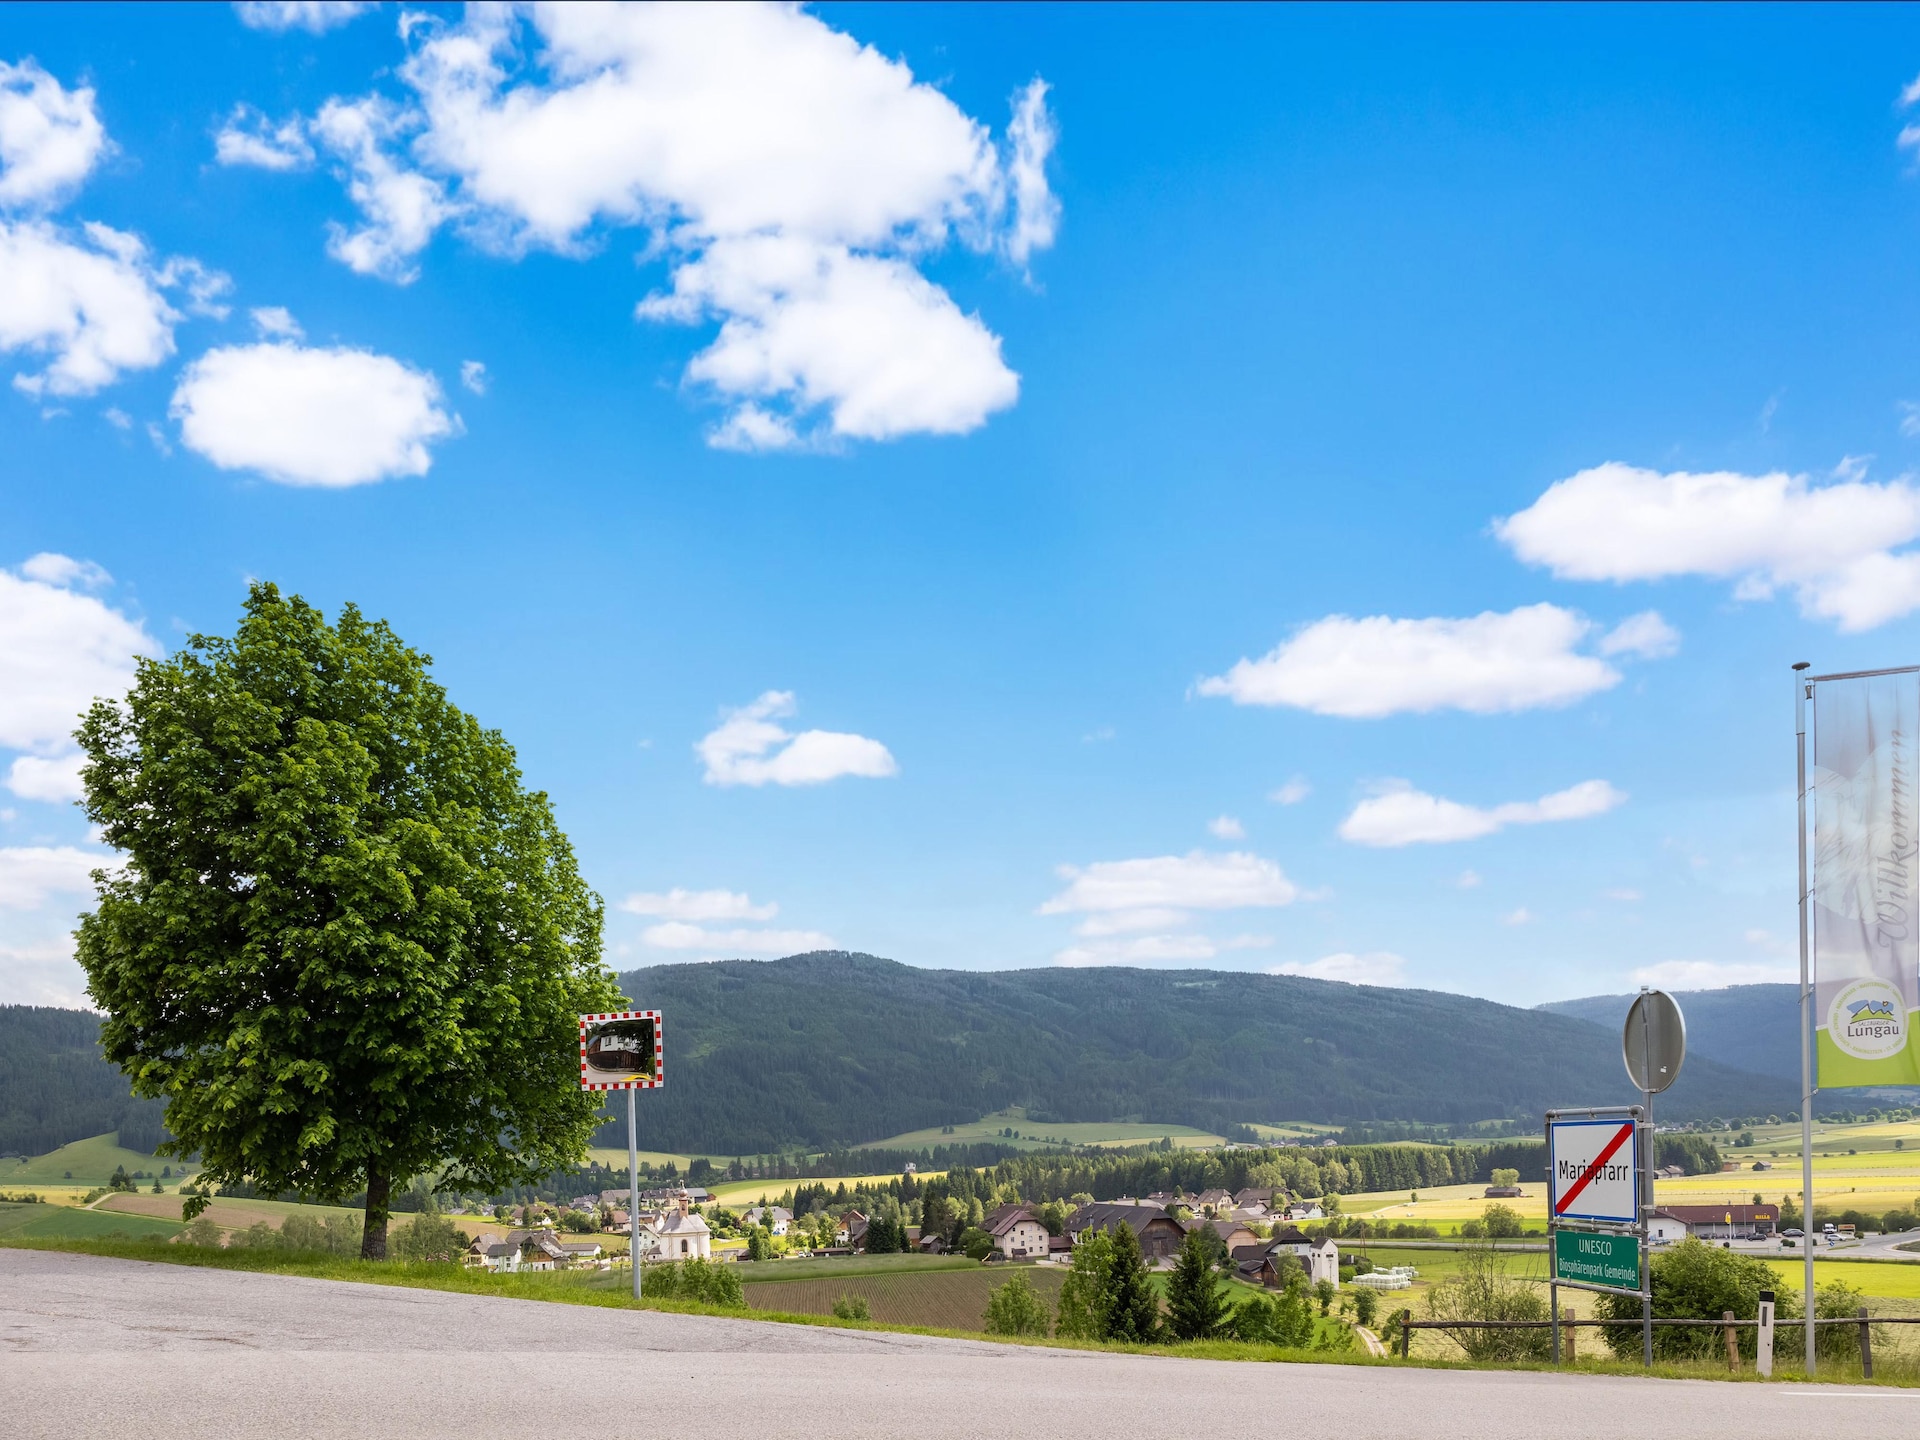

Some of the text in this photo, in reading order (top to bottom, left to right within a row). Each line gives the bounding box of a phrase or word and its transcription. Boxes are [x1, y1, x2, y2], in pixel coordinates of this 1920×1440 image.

[1877, 728, 1919, 949] Willkommen
[1847, 1025, 1900, 1039] Lungau
[1559, 1159, 1629, 1185] Mariapfarr
[1578, 1239, 1612, 1256] UNESCO
[1559, 1257, 1636, 1282] Biosphärenpark Gemeinde
